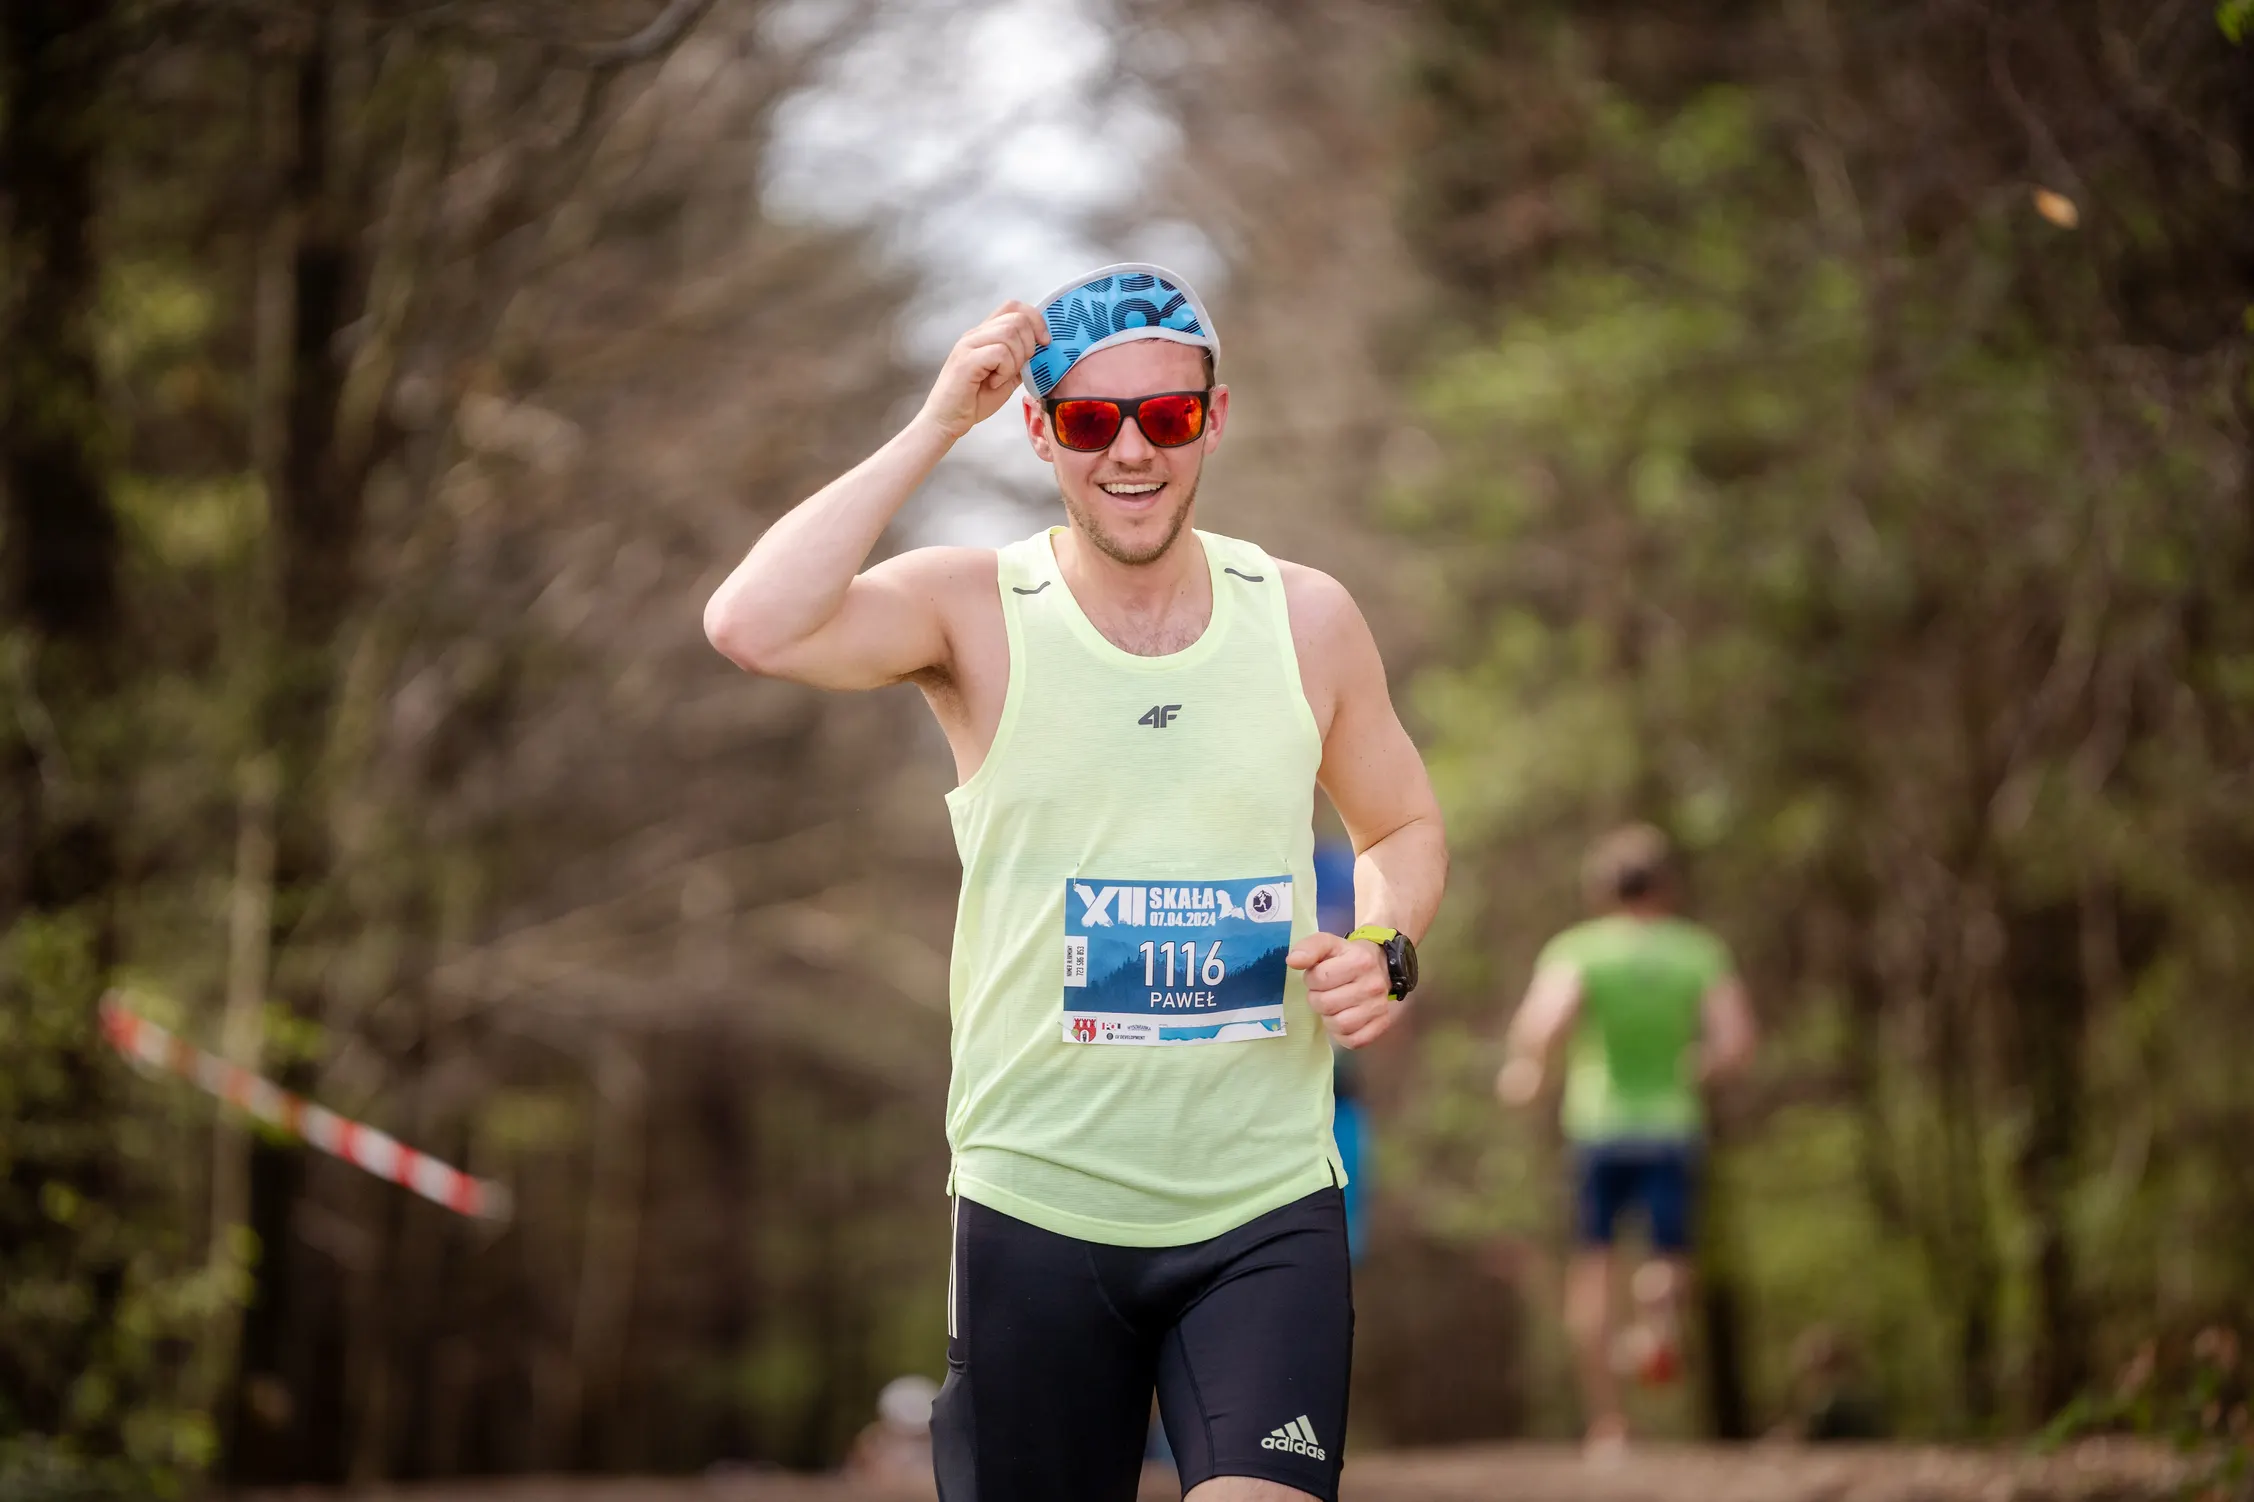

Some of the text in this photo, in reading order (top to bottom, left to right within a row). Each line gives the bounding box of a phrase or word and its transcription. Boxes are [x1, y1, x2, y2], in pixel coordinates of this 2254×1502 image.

[1138, 704, 1182, 728] 4F
[1074, 884, 1146, 927] XII
[1149, 887, 1215, 909] SKAŁA
[1149, 911, 1216, 926] 07.04.2024
[1139, 940, 1226, 988] 1116
[1150, 991, 1217, 1008] PAWEŁ
[1261, 1436, 1326, 1461] adidas
